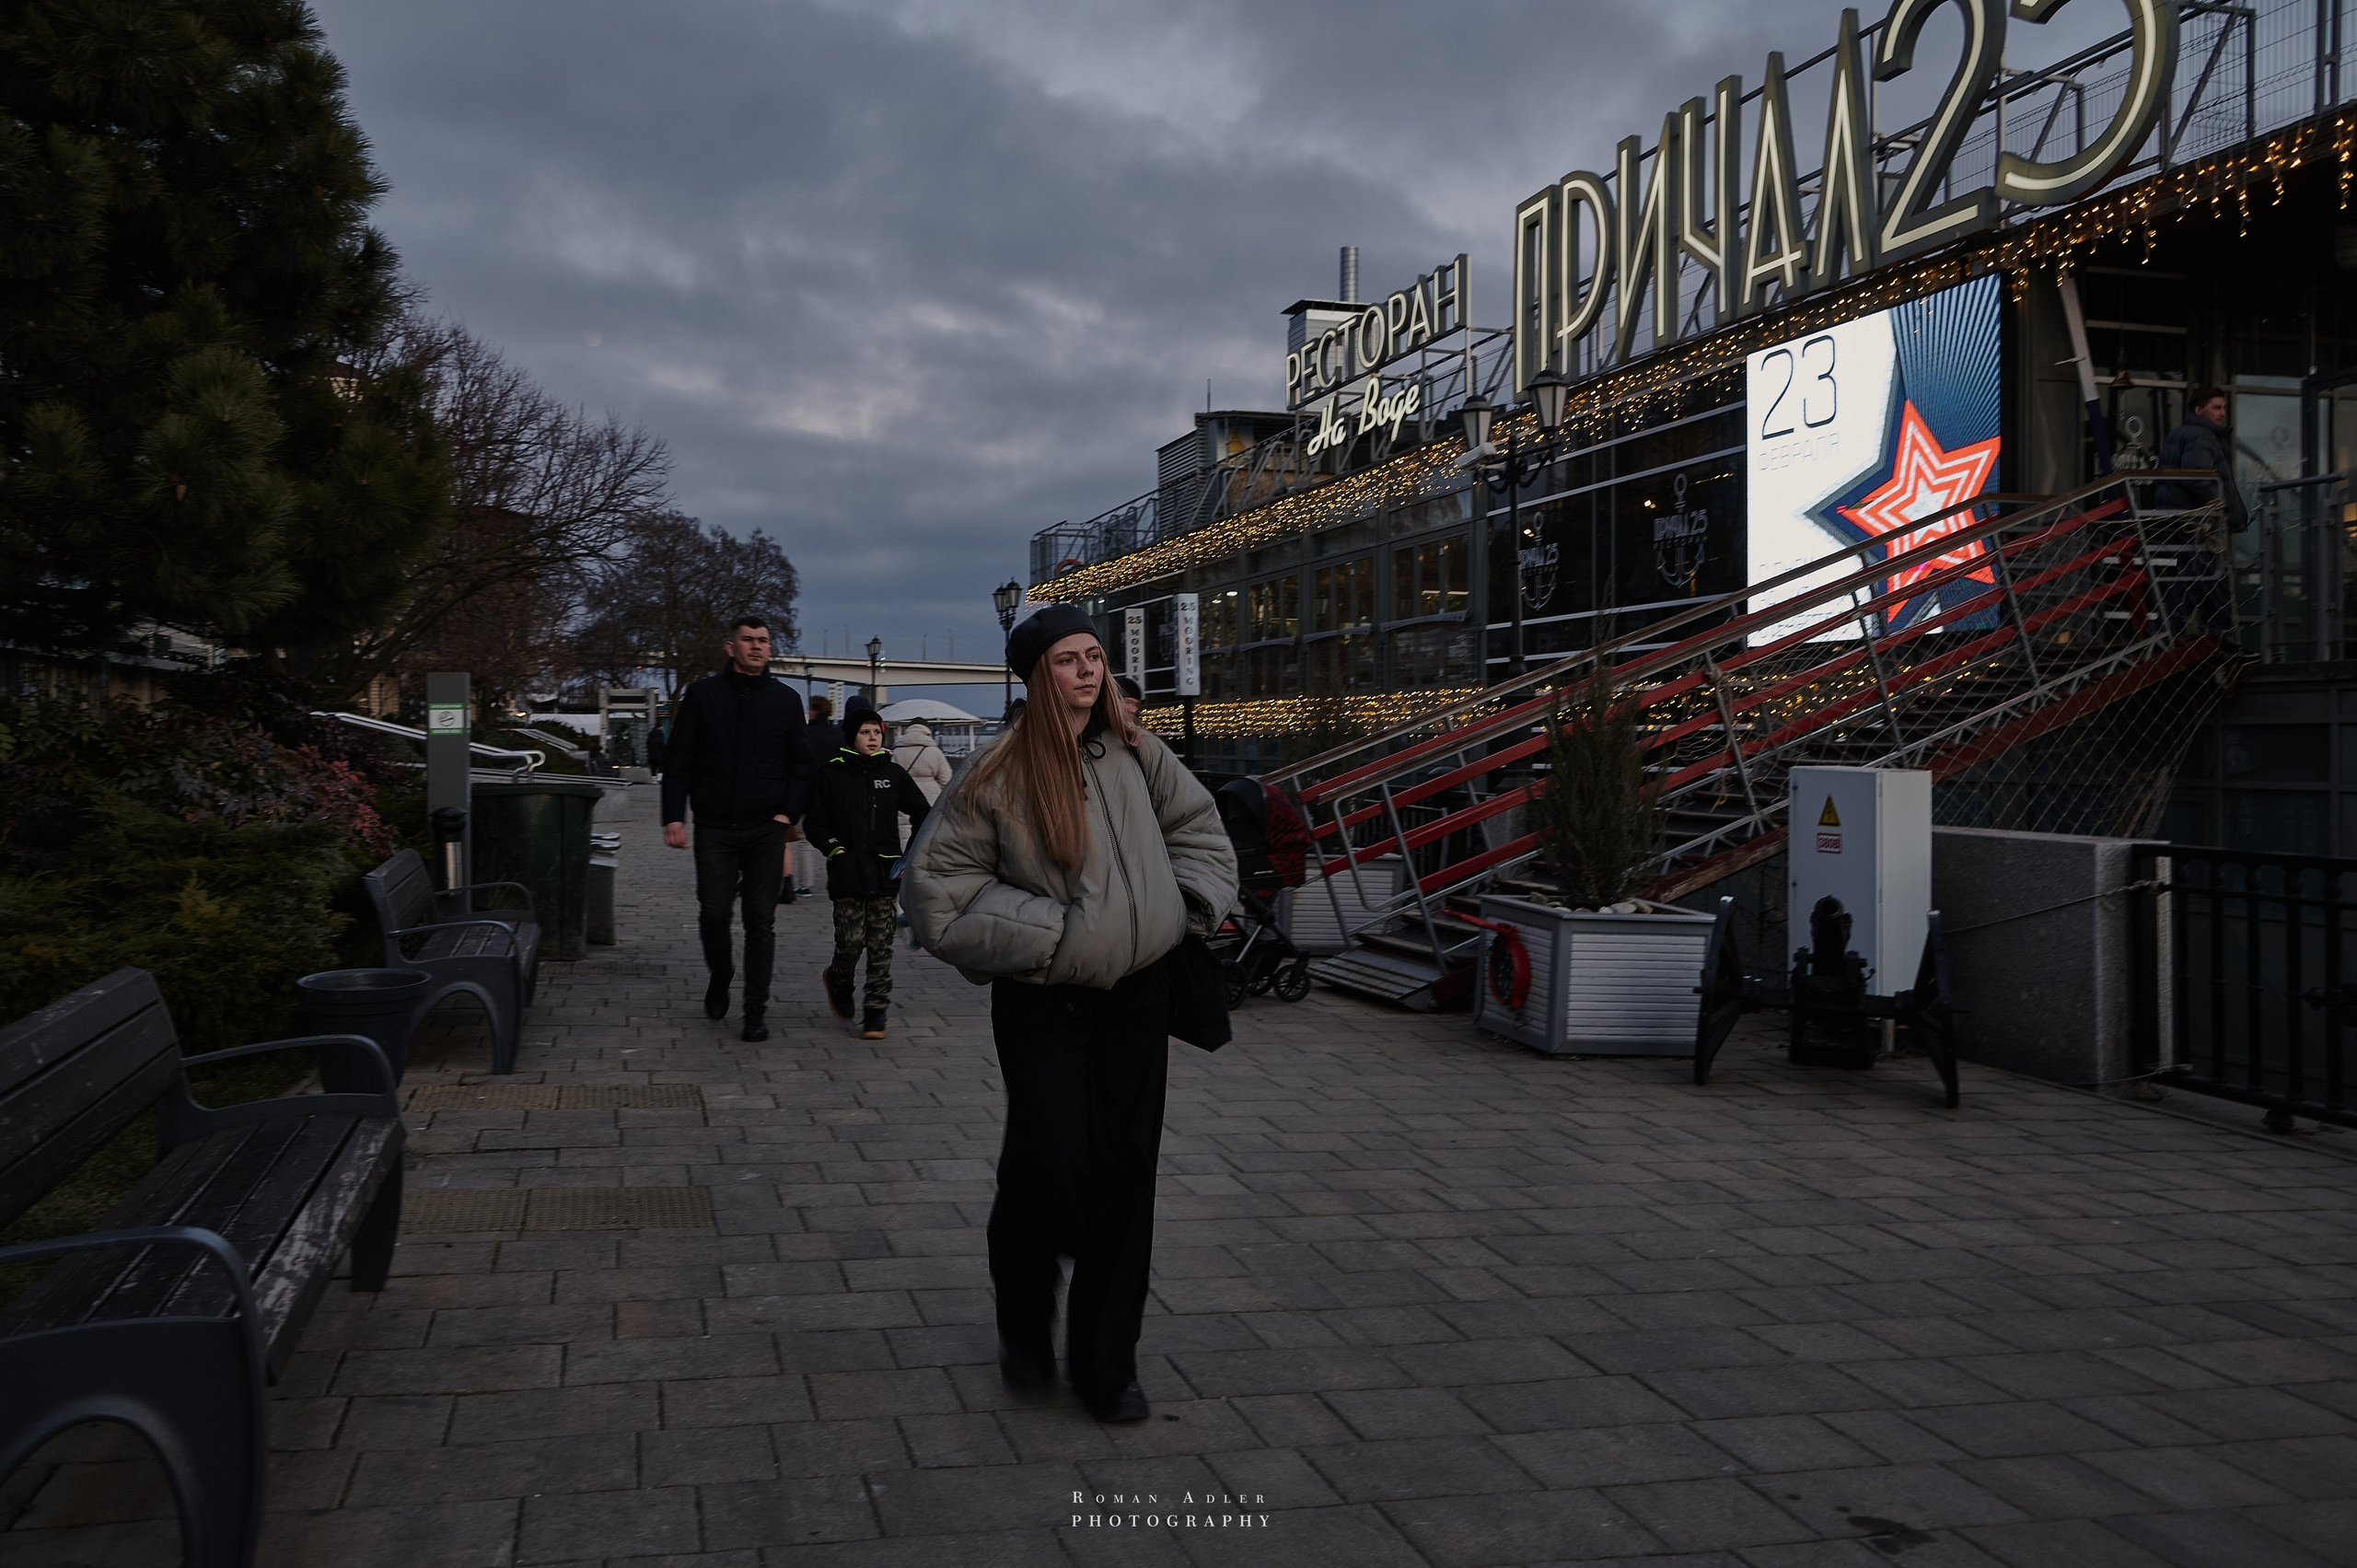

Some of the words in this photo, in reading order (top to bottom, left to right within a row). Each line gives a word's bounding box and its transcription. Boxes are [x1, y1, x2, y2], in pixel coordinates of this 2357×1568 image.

[1515, 8, 1873, 402] ПРИЧАЛ
[1286, 254, 1468, 411] РЕСТОРАН
[1306, 397, 1347, 456] На
[1358, 377, 1420, 442] Воде
[1760, 334, 1837, 440] 23
[1128, 616, 1142, 624] 25
[1181, 602, 1196, 611] 25
[1131, 629, 1140, 681] MOORIN
[1184, 617, 1194, 685] MOORING
[874, 779, 891, 789] RC
